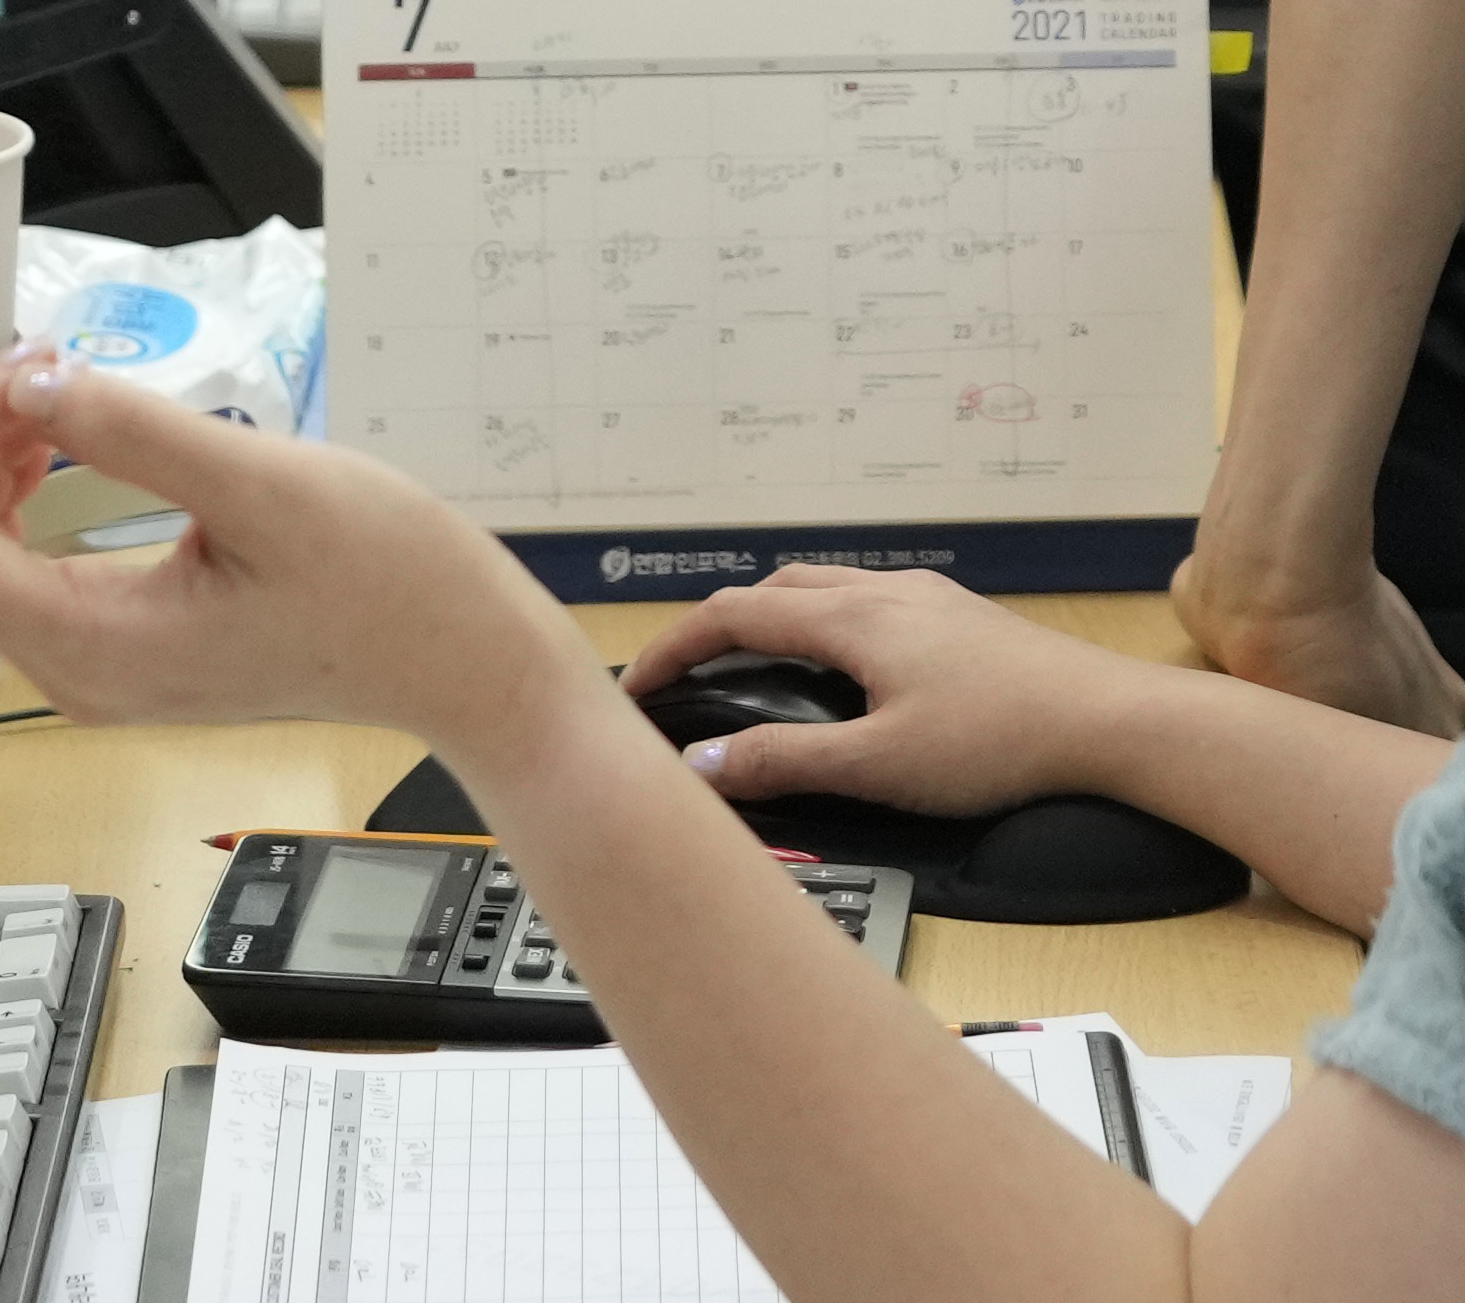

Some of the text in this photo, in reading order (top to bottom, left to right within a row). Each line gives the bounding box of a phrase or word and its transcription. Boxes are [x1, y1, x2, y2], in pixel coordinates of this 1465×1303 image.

[1011, 8, 1088, 41] 2021
[1098, 10, 1177, 25] TRADING
[1099, 25, 1178, 41] CALENDAR
[948, 79, 959, 94] 2
[1066, 76, 1077, 92] 3
[833, 162, 844, 178] 8
[1068, 158, 1084, 173] 10
[834, 243, 852, 259] 15
[952, 242, 969, 258] 16
[1068, 239, 1084, 255] 17
[602, 330, 622, 346] 20
[718, 327, 736, 344] 21
[836, 325, 856, 342] 22
[953, 323, 972, 340] 23
[1070, 321, 1089, 338] 24
[601, 411, 622, 429] 27
[720, 409, 740, 426] 28
[837, 407, 857, 424] 29
[955, 405, 975, 422] 30
[1071, 403, 1089, 420] 31
[366, 416, 388, 434] 25
[485, 414, 505, 432] 26
[633, 551, 758, 576] 연합인포맥스
[226, 933, 254, 965] CASIO
